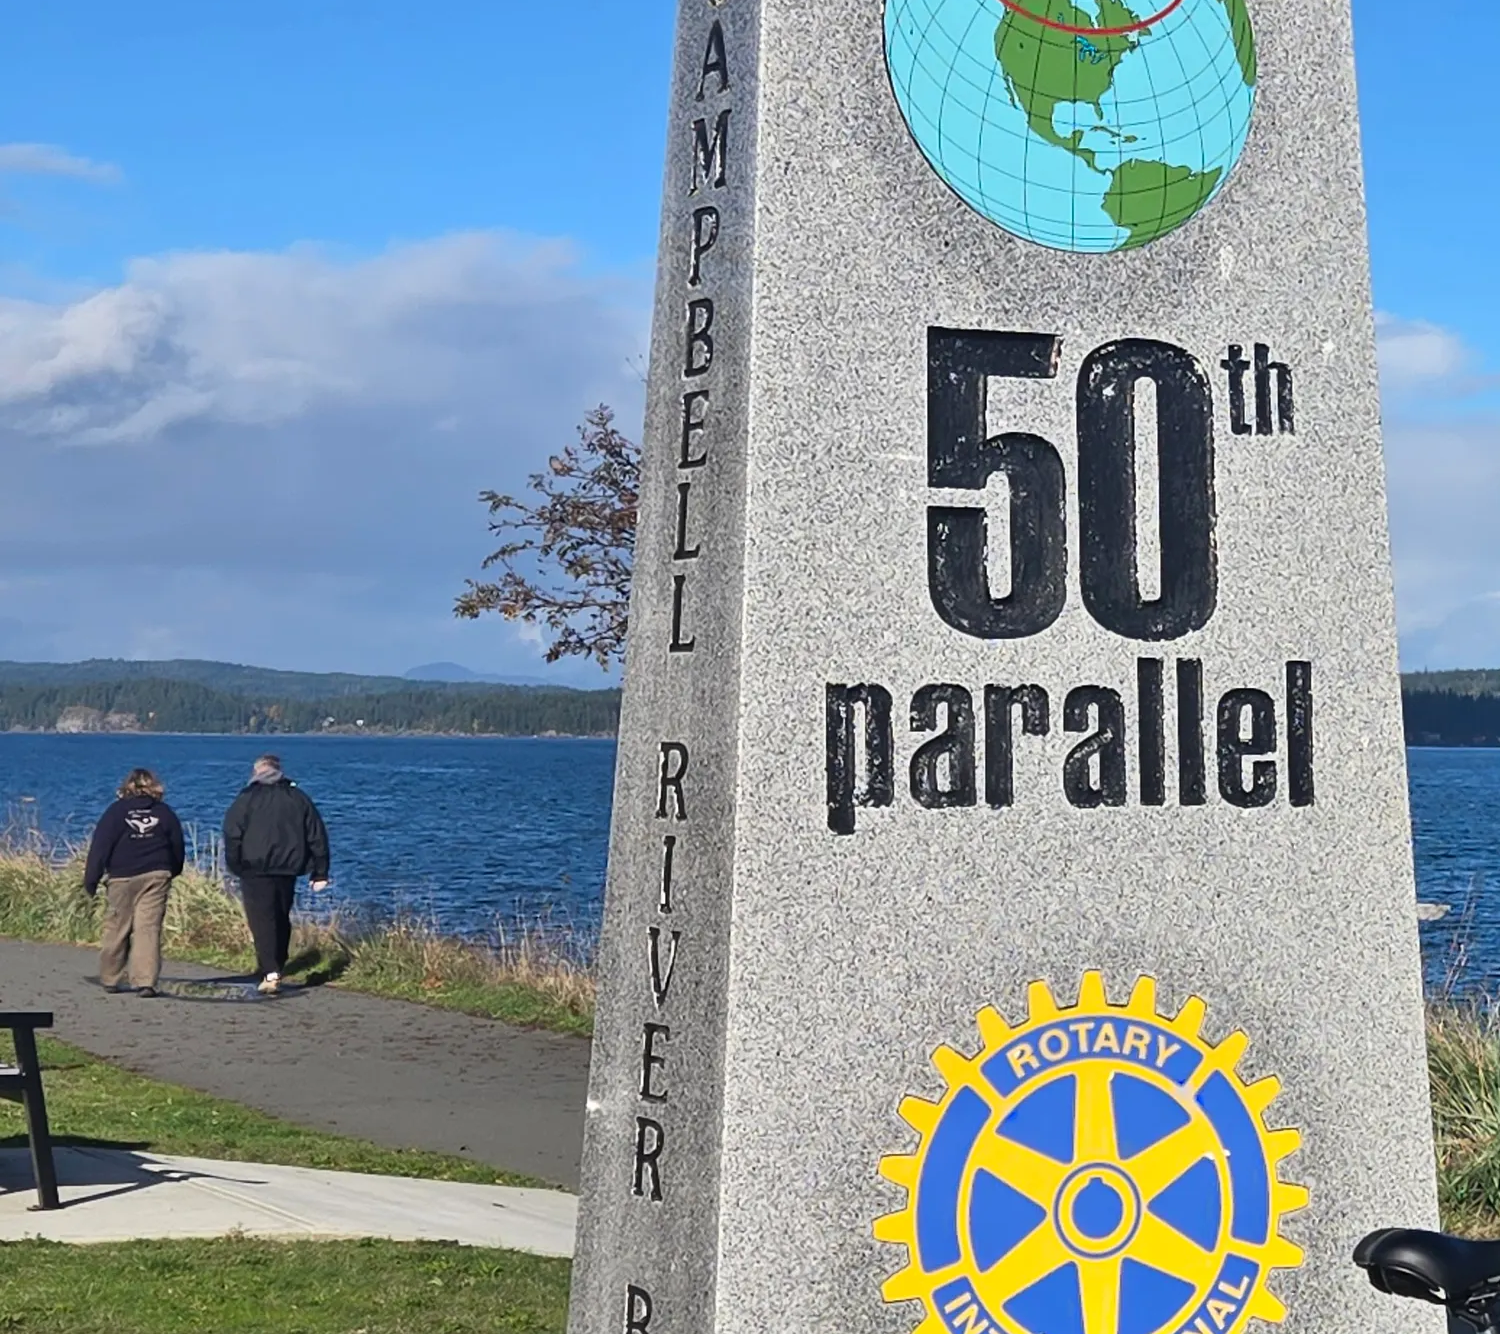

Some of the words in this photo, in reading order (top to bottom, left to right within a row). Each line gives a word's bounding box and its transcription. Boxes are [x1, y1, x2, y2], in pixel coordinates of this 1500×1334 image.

[926, 325, 1296, 643] 50th
[825, 656, 1315, 835] parallel
[630, 740, 690, 1203] RIVER
[1005, 1021, 1182, 1080] ROTARY
